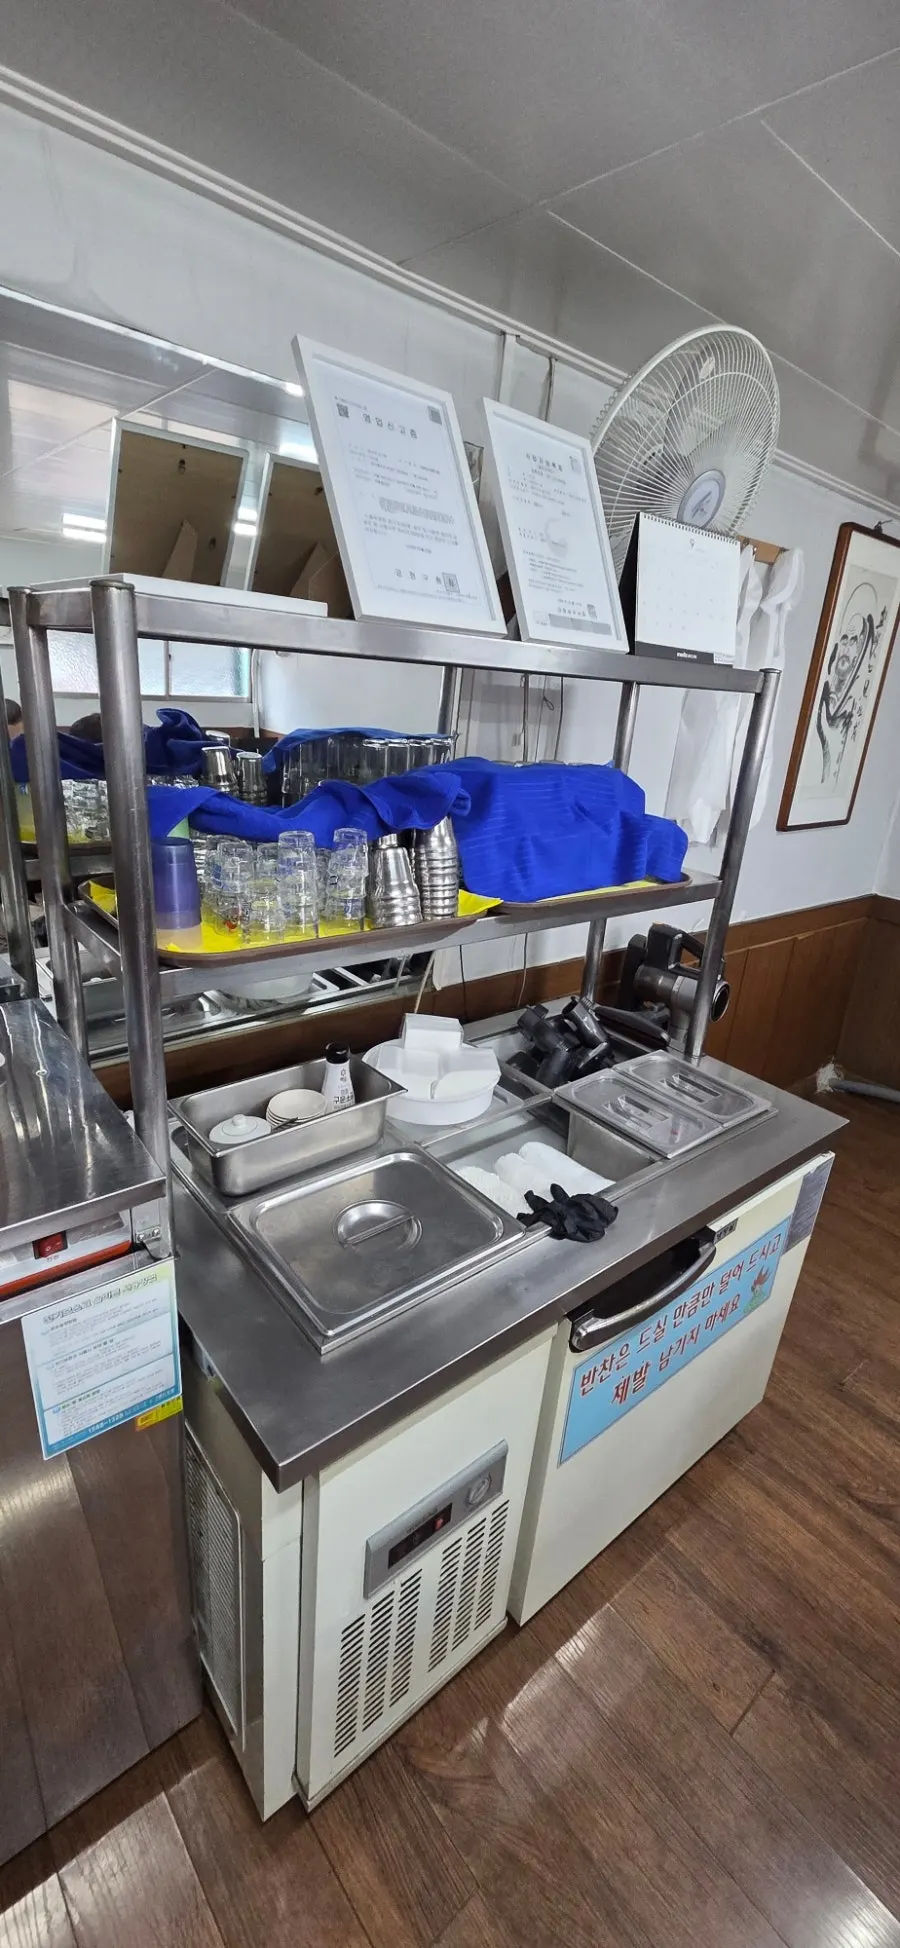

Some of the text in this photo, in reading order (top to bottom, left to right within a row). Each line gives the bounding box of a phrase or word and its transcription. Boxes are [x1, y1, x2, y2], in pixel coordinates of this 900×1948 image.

[579, 1233, 782, 1396] 반찬은 드실 만큼만 덜어 드시고
[610, 1294, 742, 1406] 제발 남기지 마세요
